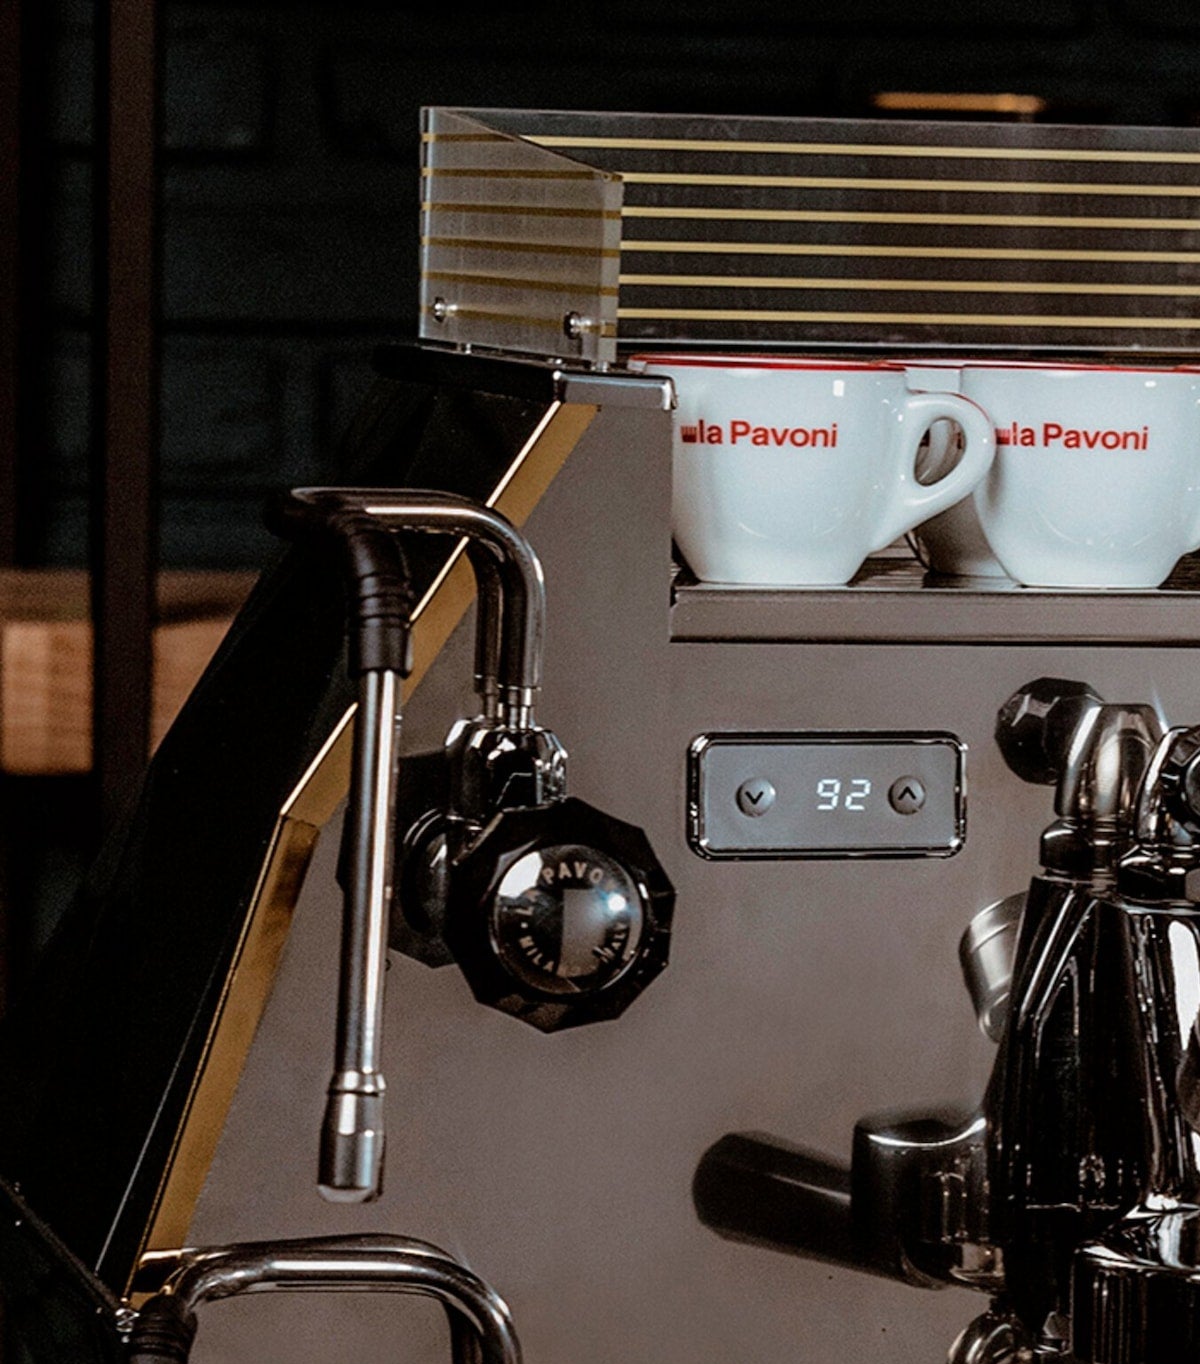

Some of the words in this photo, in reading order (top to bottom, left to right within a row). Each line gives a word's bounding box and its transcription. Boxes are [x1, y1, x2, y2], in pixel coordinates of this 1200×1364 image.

[699, 420, 723, 444] la
[729, 420, 839, 449] Pavoni
[1012, 422, 1036, 447] la
[1042, 423, 1149, 451] Pavoni
[816, 778, 871, 810] 92
